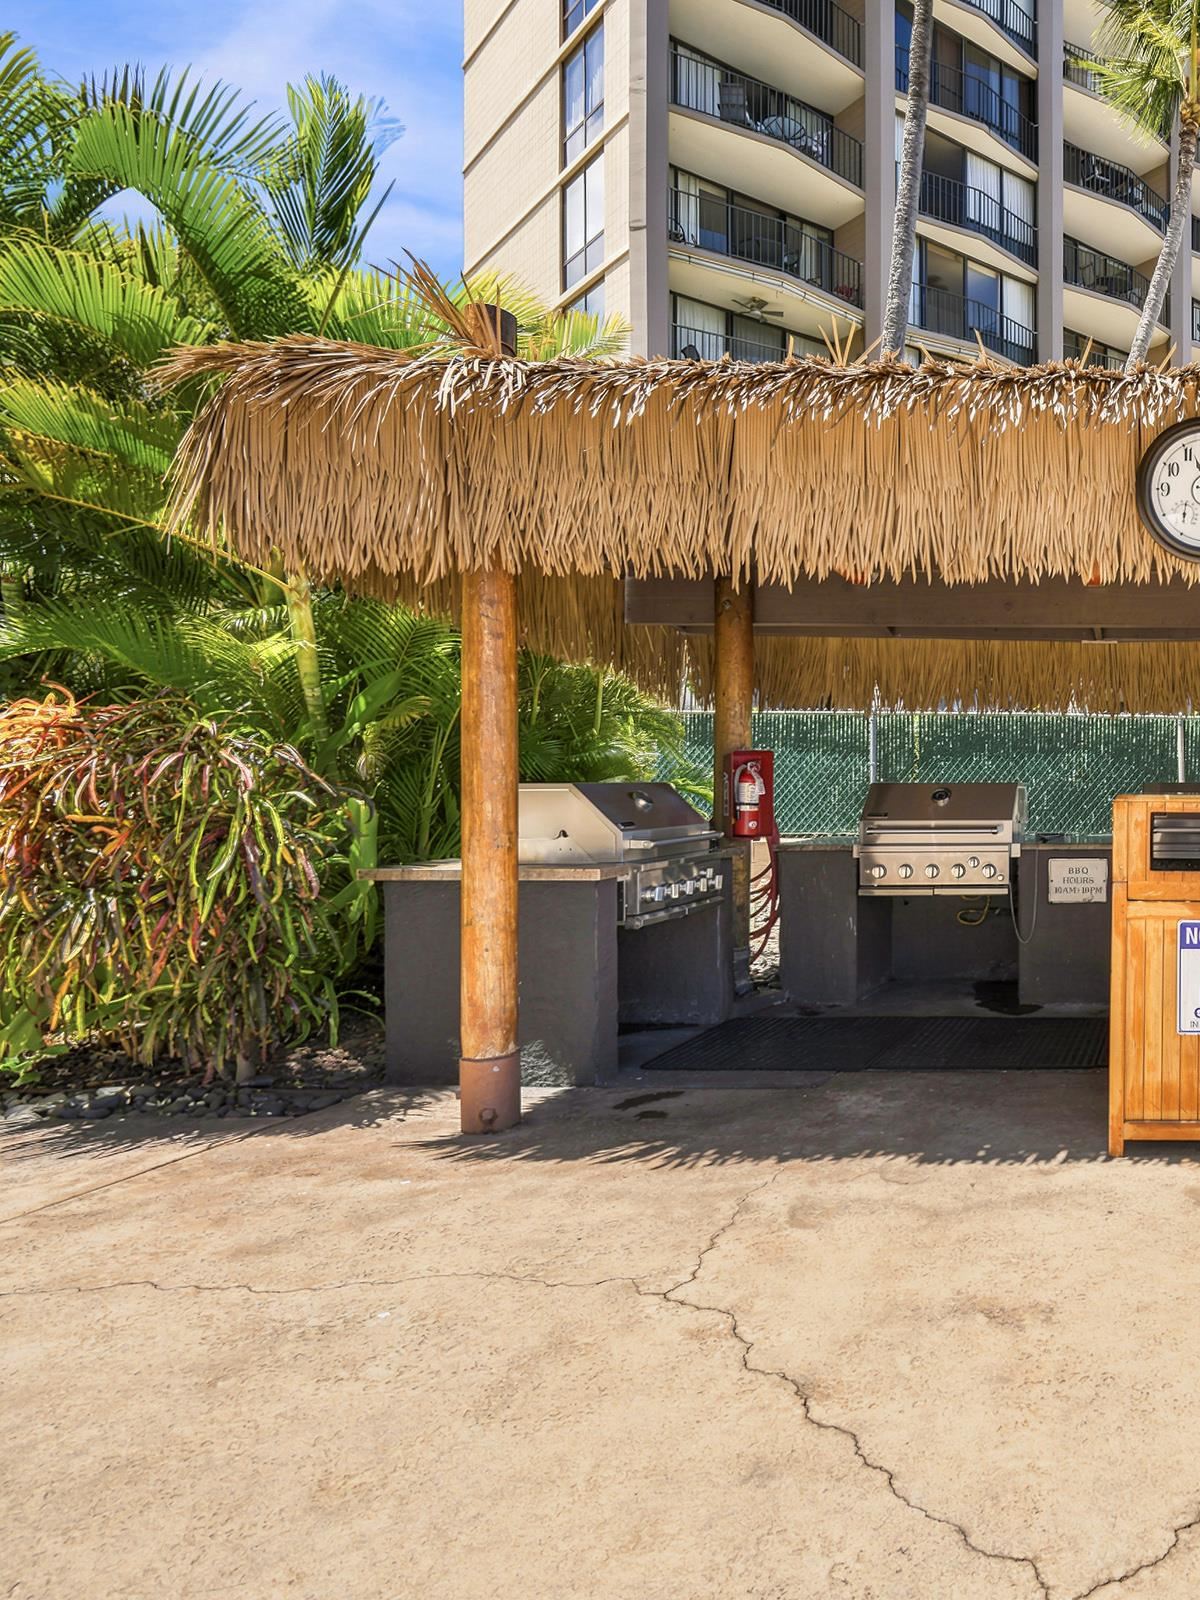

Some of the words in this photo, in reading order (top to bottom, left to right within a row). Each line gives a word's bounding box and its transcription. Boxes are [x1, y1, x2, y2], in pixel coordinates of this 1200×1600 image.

[1184, 447, 1193, 461] 11
[1167, 462, 1180, 477] 10
[1160, 482, 1170, 497] 9
[1068, 866, 1089, 875] BBQ
[1062, 876, 1095, 884] HOURS
